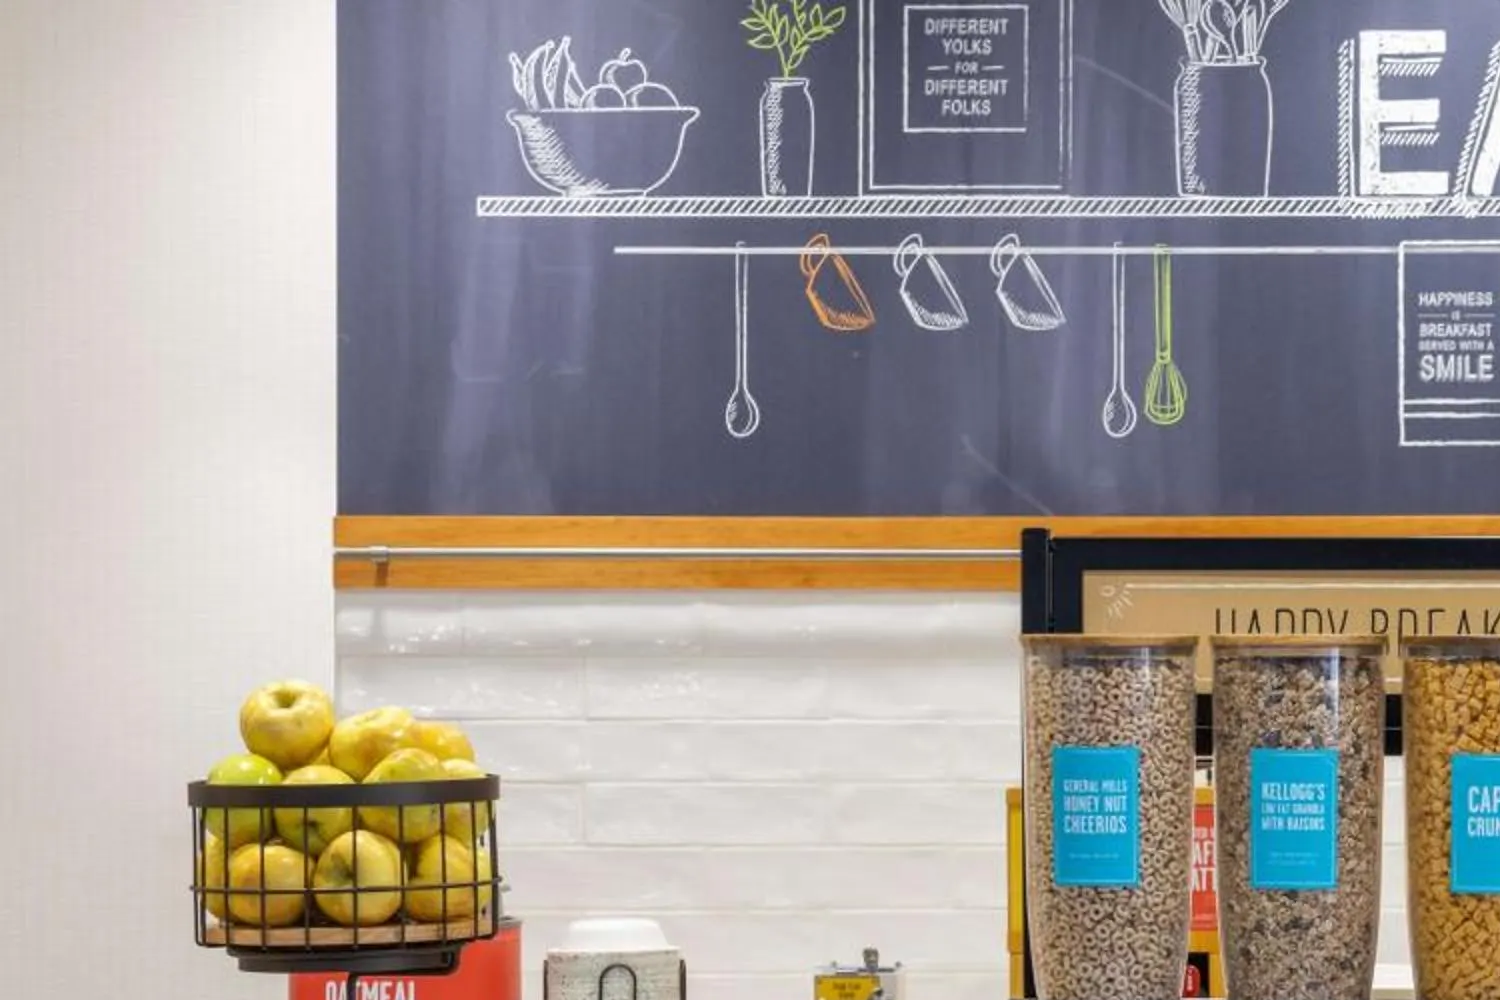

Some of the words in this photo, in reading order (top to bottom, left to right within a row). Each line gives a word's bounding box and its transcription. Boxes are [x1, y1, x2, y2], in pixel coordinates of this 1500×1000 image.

[924, 18, 1009, 35] DIFFERENT
[942, 38, 992, 55] YOLKS
[955, 61, 979, 75] FOR
[924, 79, 1009, 96] DIFFERENT
[942, 99, 992, 116] FOLKS
[1418, 291, 1494, 306] HAPPINESS
[1419, 323, 1492, 337] BREAKFAST
[1459, 340, 1485, 352] WITH
[1486, 340, 1495, 352] A
[1420, 354, 1495, 382] SMILE
[1102, 779, 1127, 793] MILLS
[1261, 783, 1325, 801] KELLOGG'S
[1063, 795, 1099, 813] HONEY
[1103, 795, 1127, 813] NUT
[1063, 815, 1127, 834] CHEERIOS
[1261, 816, 1285, 831] WITH
[1287, 816, 1325, 831] RAISINS
